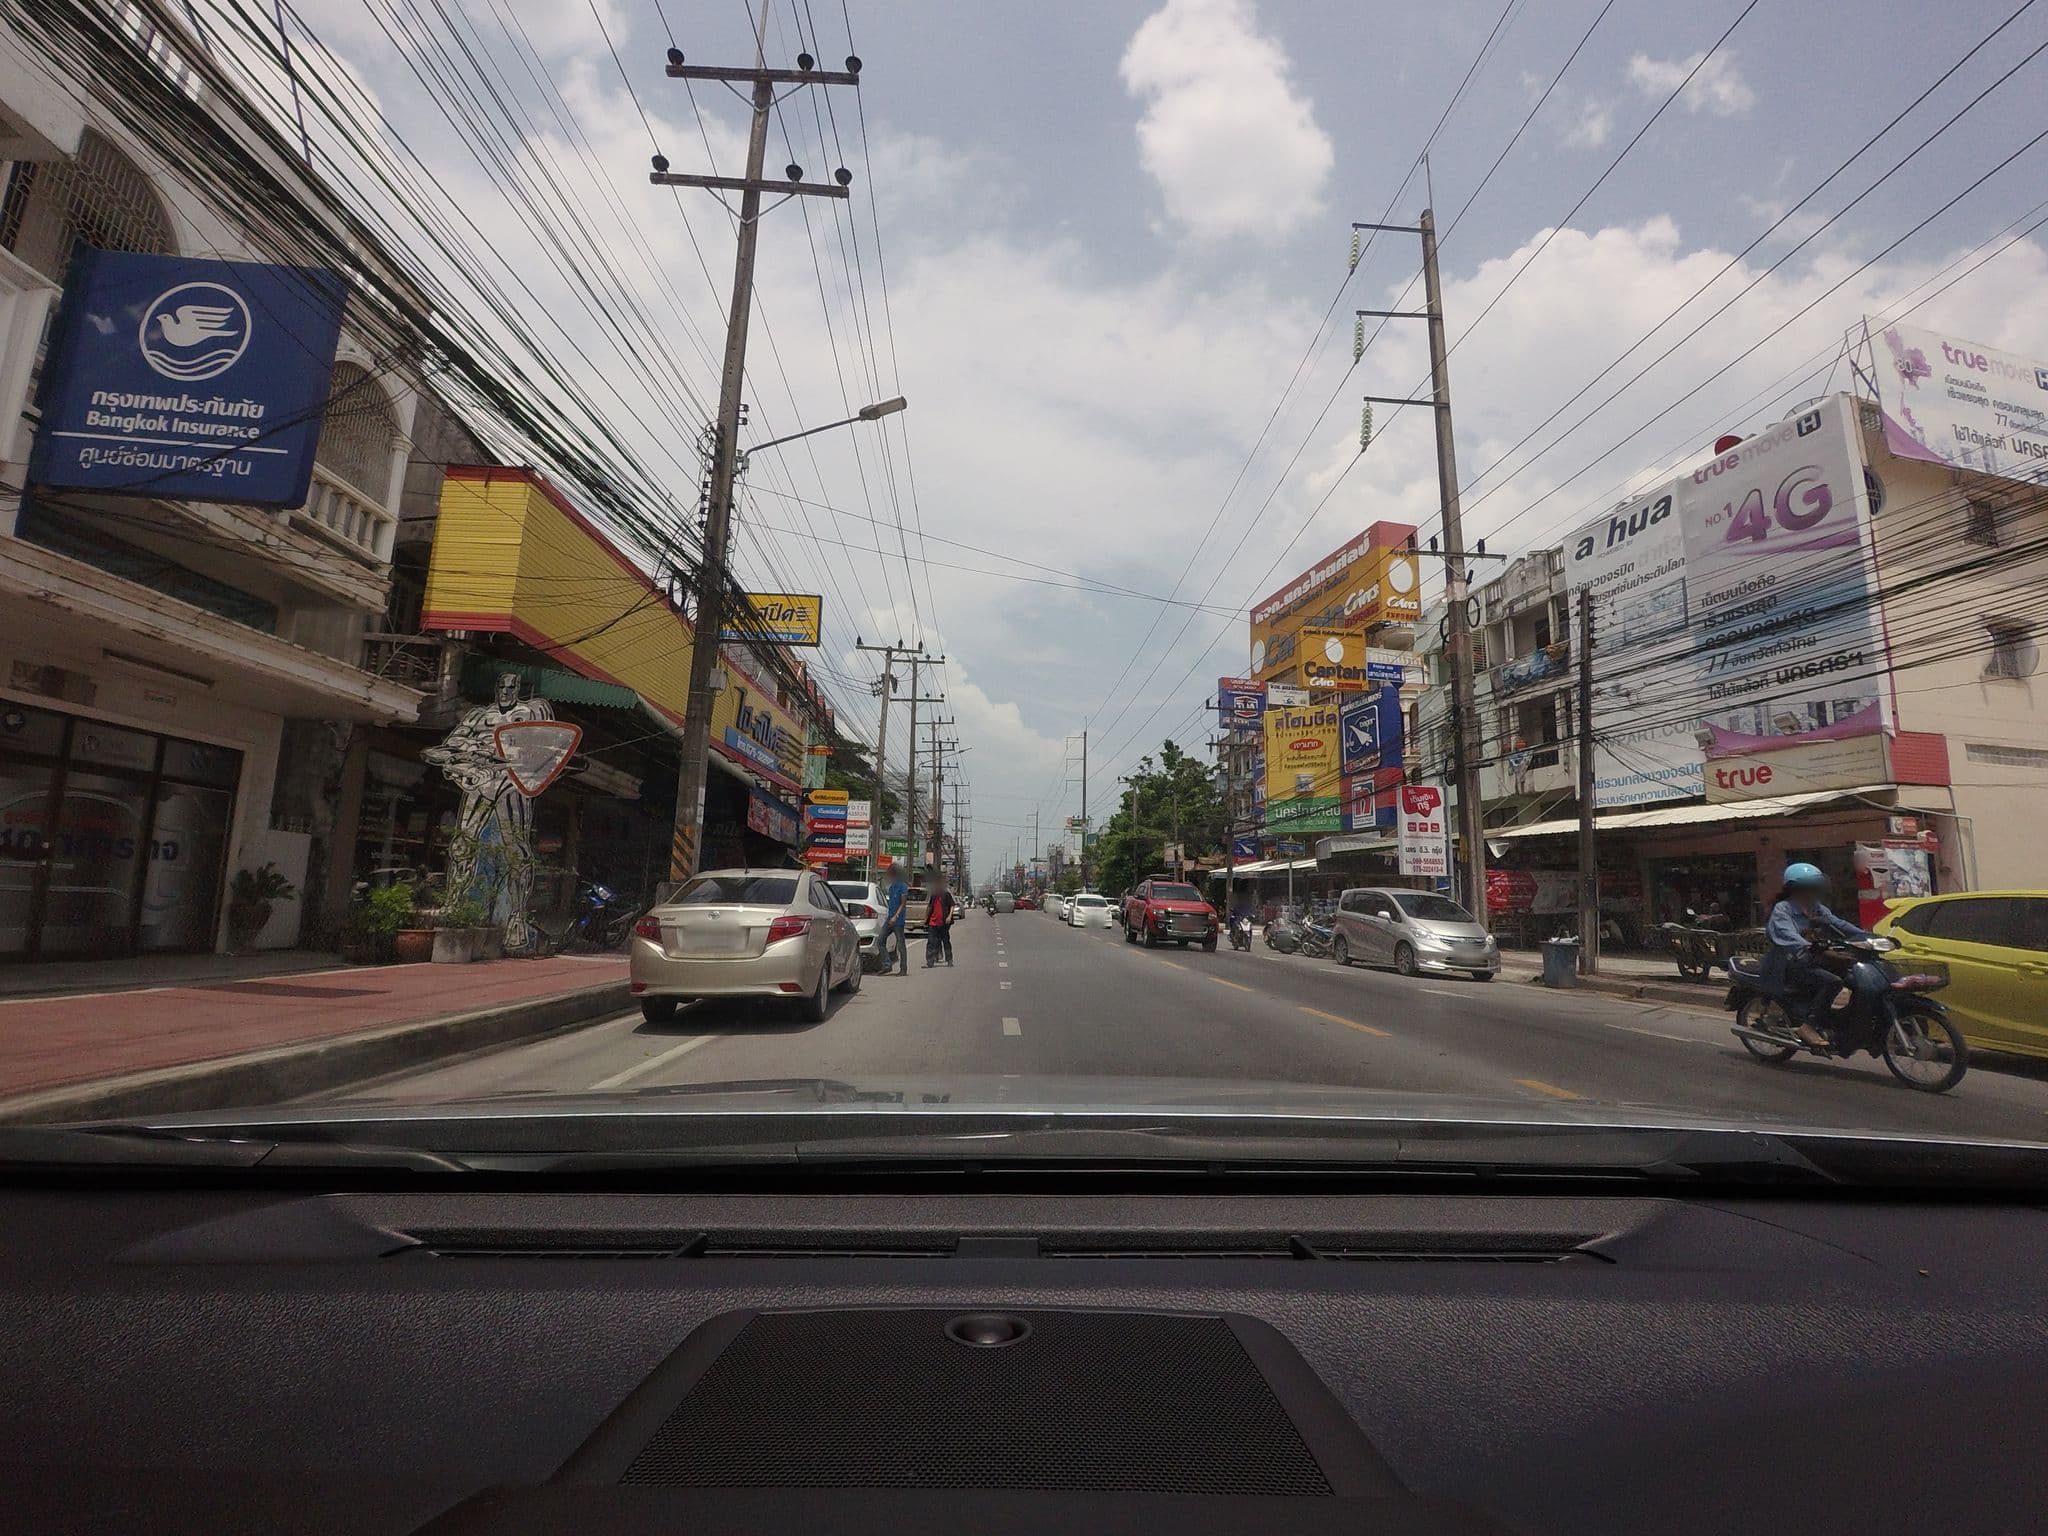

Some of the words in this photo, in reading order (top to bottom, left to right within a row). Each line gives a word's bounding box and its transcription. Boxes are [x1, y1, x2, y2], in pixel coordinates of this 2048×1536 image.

[91, 390, 264, 419] กรุงเทพประกันภัย
[86, 411, 168, 432] Bangkok
[172, 417, 260, 440] Insurance
[79, 445, 252, 477] ศูนย์ซ่อมมาตรฐาน
[1726, 465, 1833, 543] 4G
[1304, 660, 1366, 681] Captain
[1716, 765, 1773, 789] true
